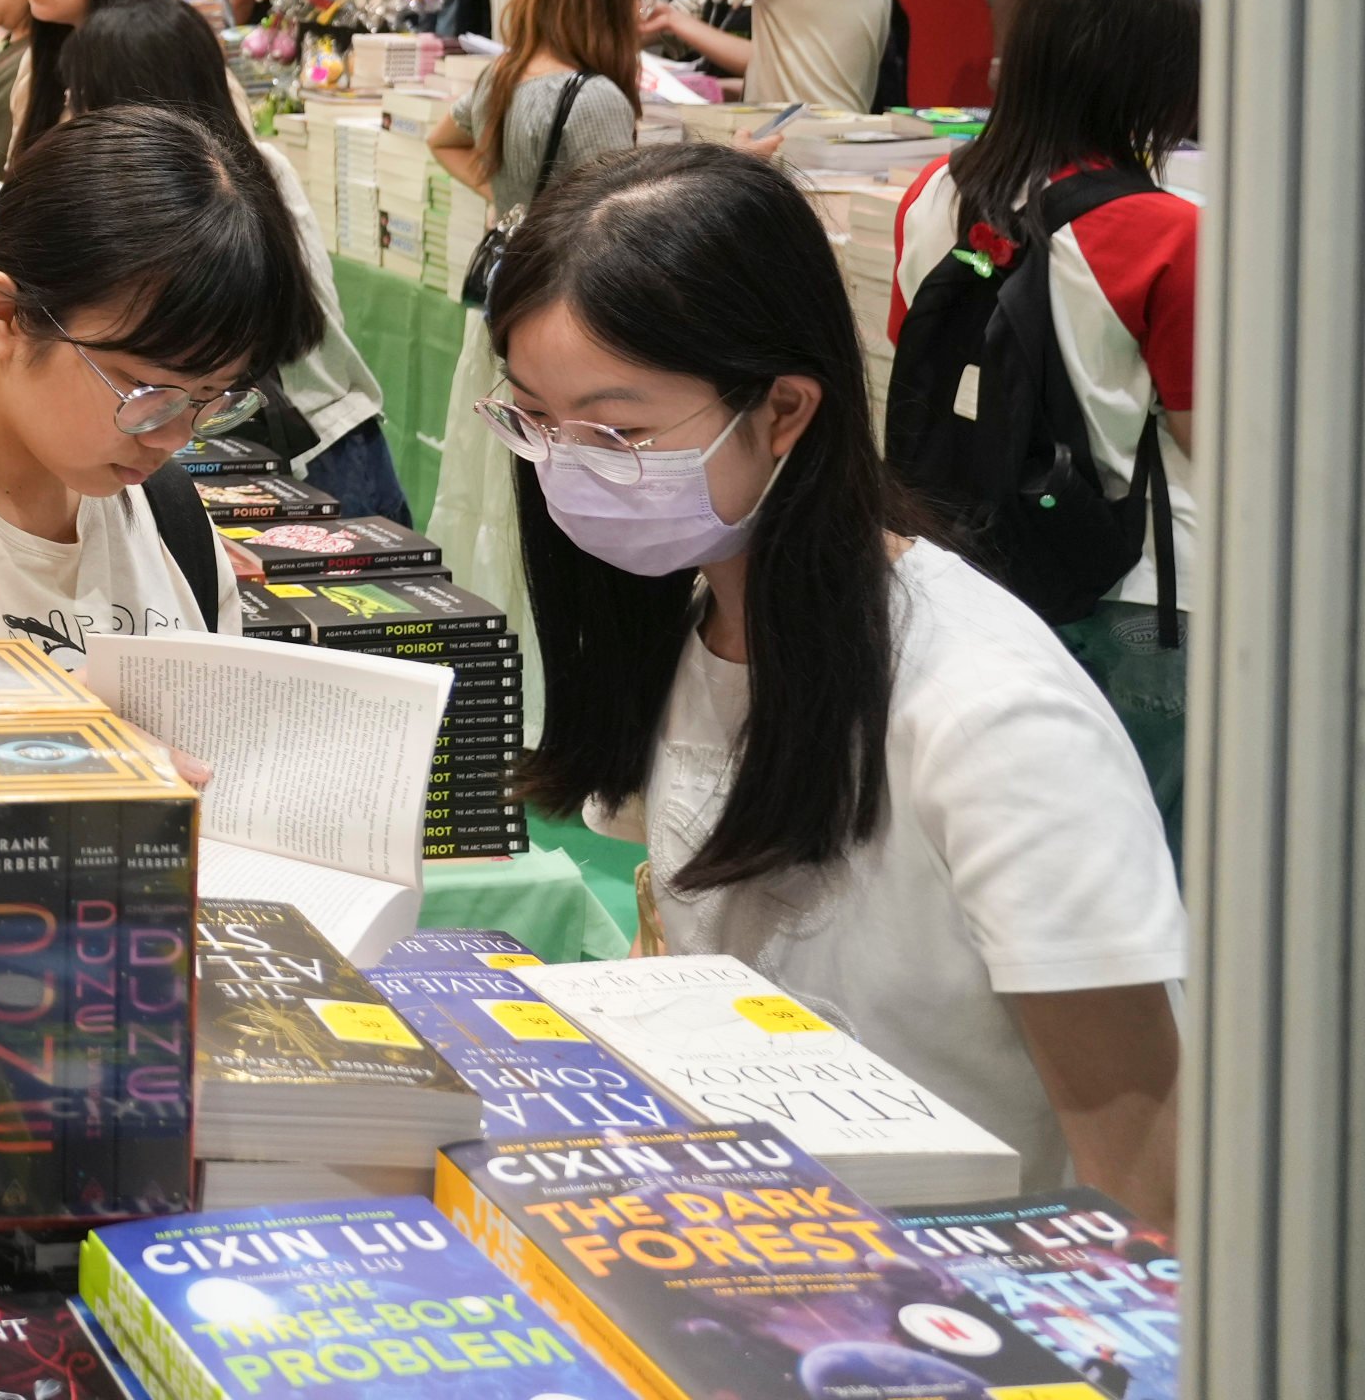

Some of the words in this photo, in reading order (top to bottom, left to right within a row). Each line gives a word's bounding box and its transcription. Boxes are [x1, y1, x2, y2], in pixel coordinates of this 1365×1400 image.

[233, 506, 275, 517] POIROT
[271, 562, 295, 571] AGATHA
[298, 560, 324, 568] CHRISTIE
[328, 556, 373, 568] POIROT
[325, 629, 350, 637] AGATHA
[352, 627, 382, 635] CHRISTIE
[385, 623, 433, 635] POIROT
[396, 642, 444, 654] POIROT
[135, 844, 180, 854] FRANK
[127, 857, 188, 869] HERBERT
[215, 981, 296, 1001] THE
[670, 1062, 893, 1086] PARADOX
[702, 1089, 938, 1124] ATLAS
[687, 1129, 738, 1141] AUTHOR
[486, 1145, 675, 1185] CIXIN
[682, 1138, 793, 1172] LIU
[674, 1169, 789, 1186] MARTINSEN
[346, 1210, 396, 1221] AUTHOR
[523, 1195, 666, 1234] THE
[664, 1185, 859, 1222] DARK
[935, 1211, 1014, 1224] BESTSELLING
[1017, 1204, 1068, 1218] AUTHOR
[1015, 1210, 1128, 1249] LIU
[142, 1228, 330, 1275] CIXIN
[341, 1220, 448, 1257] LIU
[561, 1220, 898, 1278] FOREST
[306, 1259, 353, 1277] KEN
[364, 1255, 404, 1273] LIU
[297, 1279, 378, 1304] THE
[191, 1294, 527, 1351] THREE-BODY
[223, 1327, 576, 1395] PROBLEM
